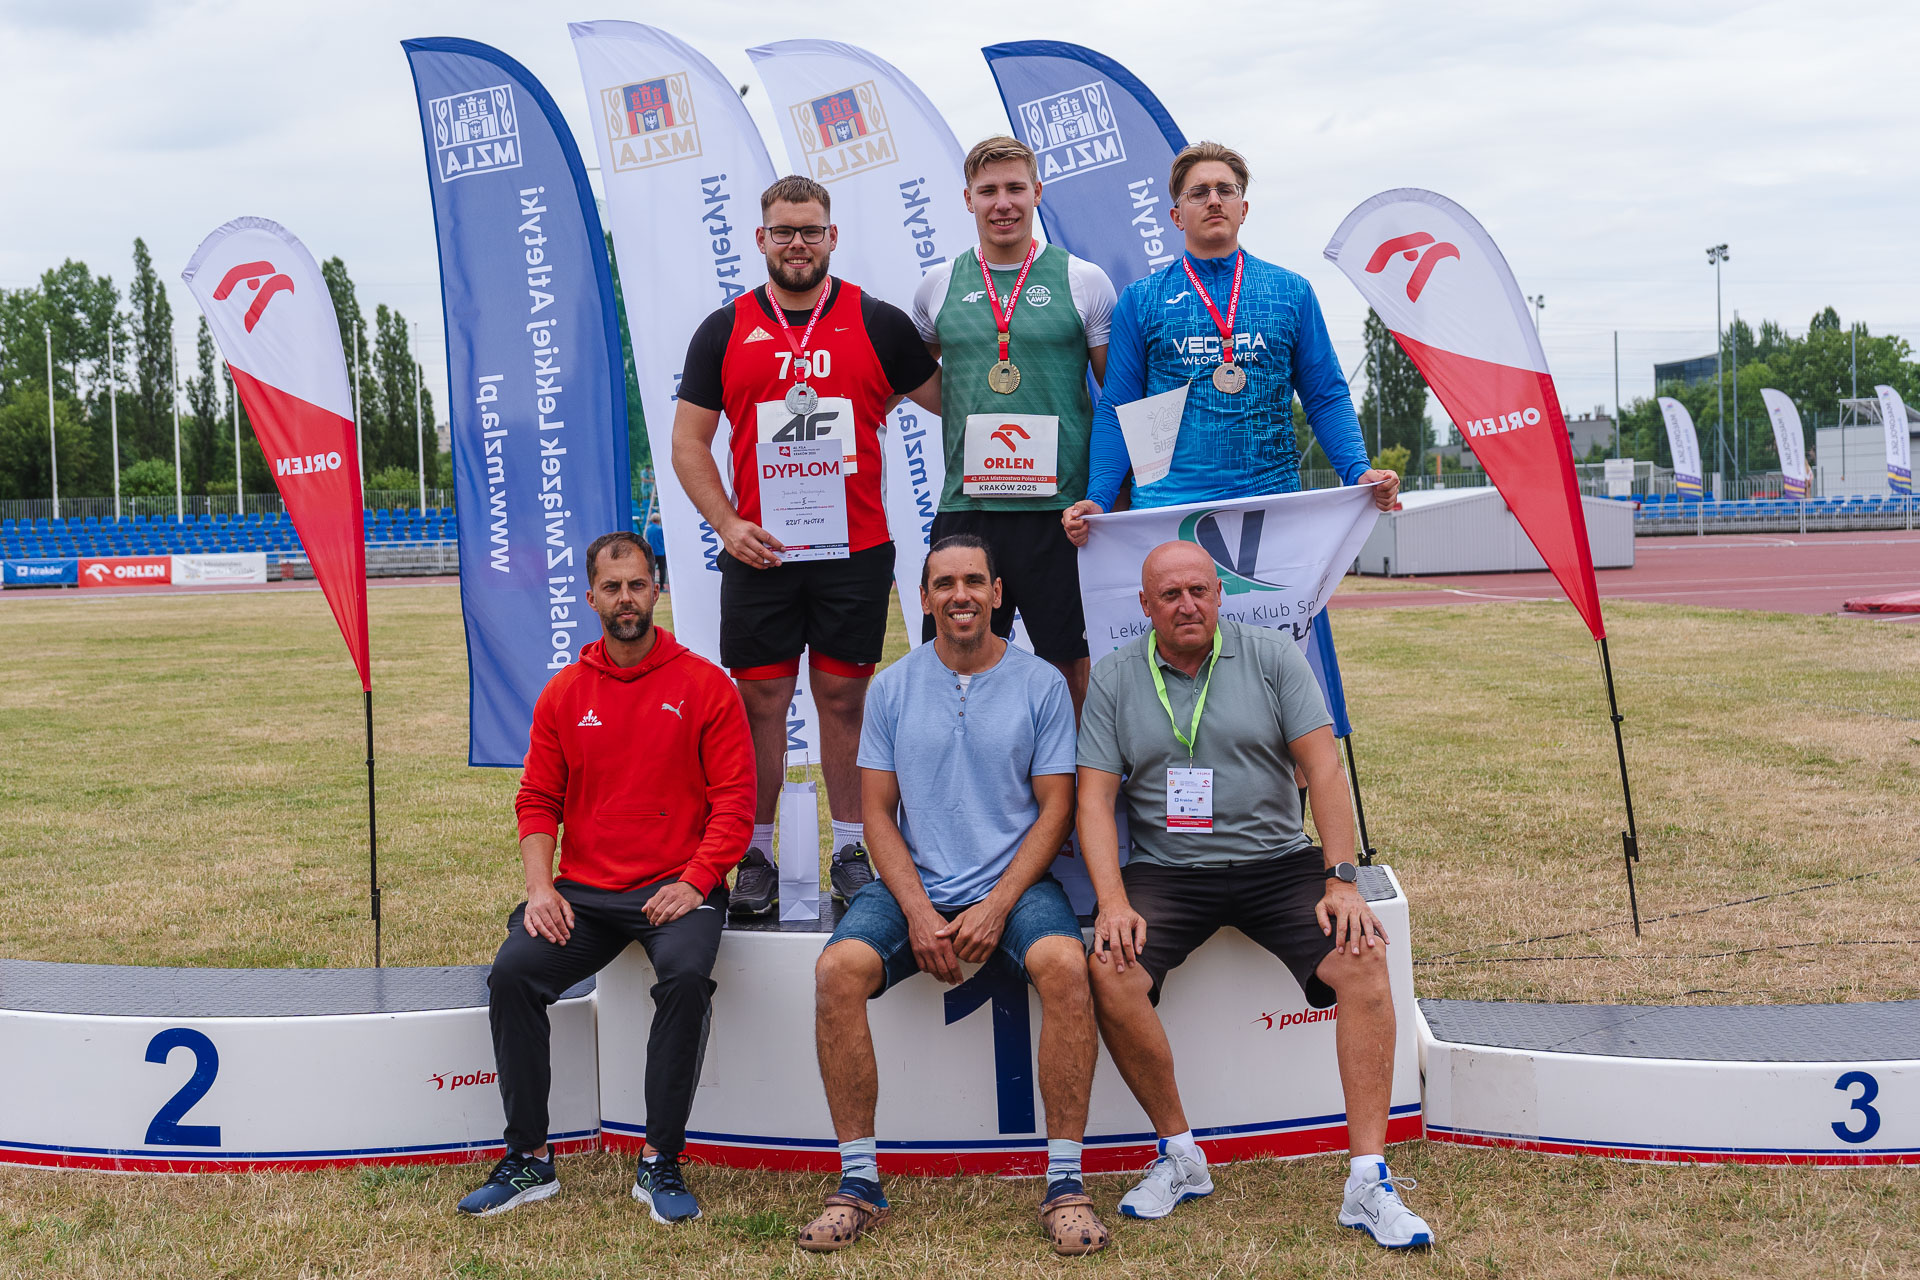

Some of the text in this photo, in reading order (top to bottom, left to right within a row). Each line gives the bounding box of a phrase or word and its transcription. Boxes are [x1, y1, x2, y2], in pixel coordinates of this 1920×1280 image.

[1016, 246, 1036, 286] MISTRZOSTWA
[962, 290, 986, 303] 4F
[1009, 286, 1021, 308] POLSKI
[1230, 292, 1238, 315] POLSKI
[1004, 307, 1013, 322] 2025
[1226, 313, 1234, 329] 2025
[806, 316, 818, 335] POLSKI
[1181, 351, 1259, 366] WŁOCŁWEK
[771, 411, 839, 443] 4F
[762, 461, 840, 479] DYPLOM
[983, 457, 1034, 469] ORLEN
[979, 482, 1015, 491] KRAKÓW
[30, 566, 63, 576] Kraków
[114, 564, 165, 578] ORLEN
[1109, 621, 1147, 639] Lekk
[1252, 602, 1290, 621] Klub
[943, 958, 1036, 1134] 1
[143, 1027, 222, 1147] 2
[1830, 1071, 1881, 1144] 3
